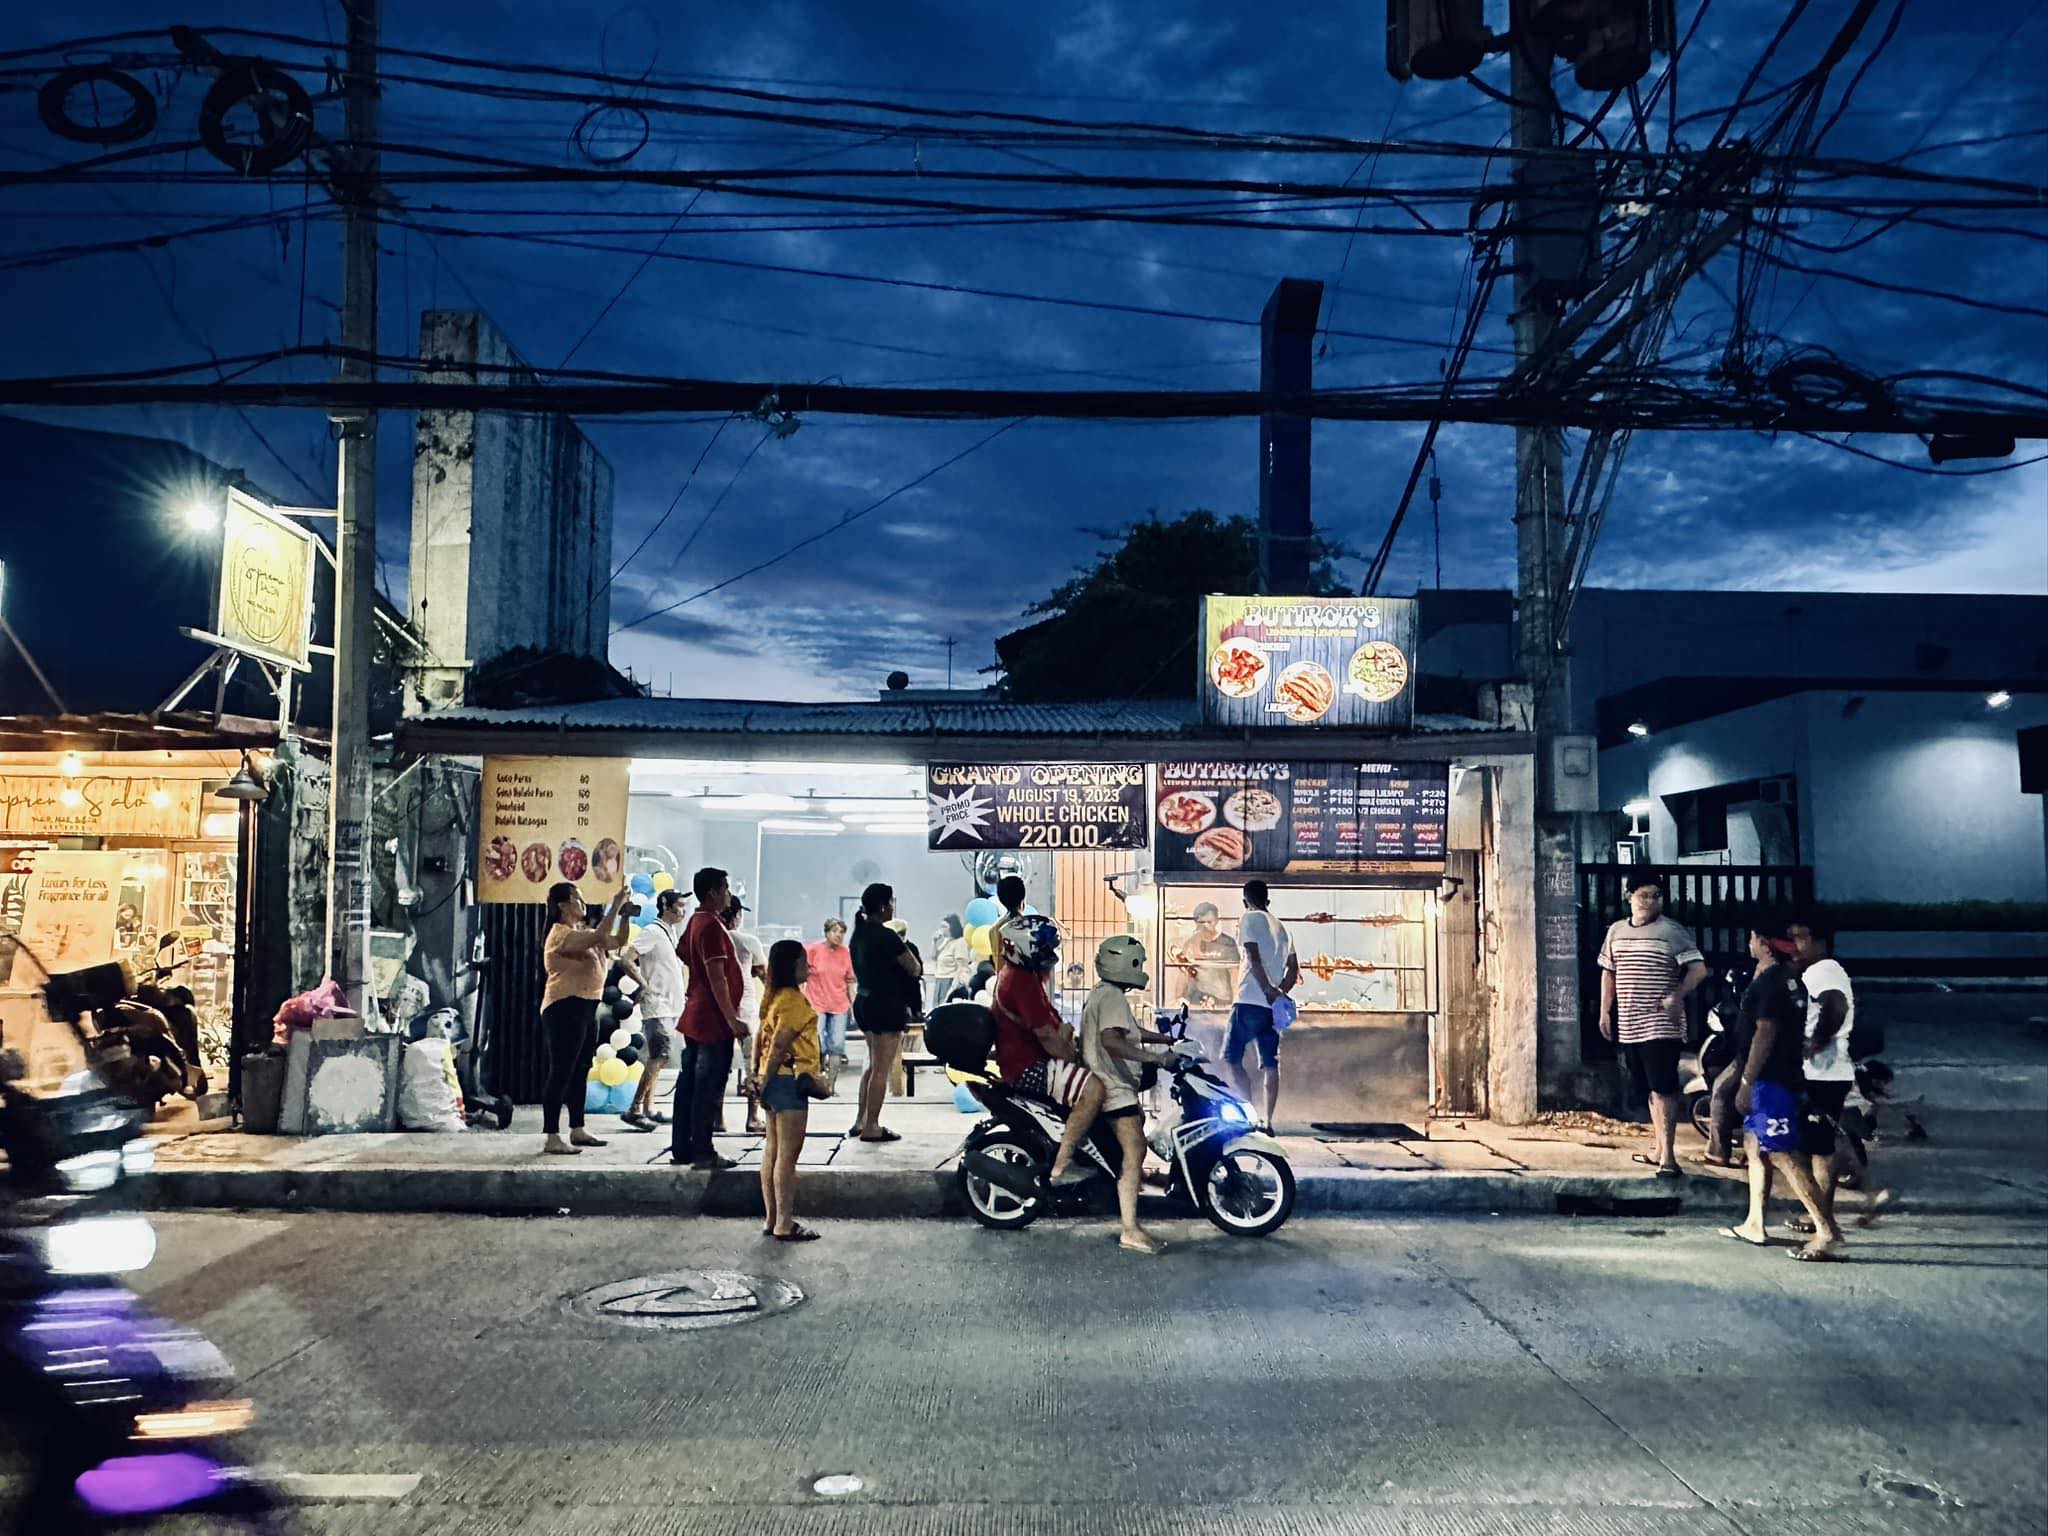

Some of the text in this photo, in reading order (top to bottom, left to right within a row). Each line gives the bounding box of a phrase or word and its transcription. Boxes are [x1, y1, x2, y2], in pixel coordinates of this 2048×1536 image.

[931, 765, 1143, 785] GRAND OPENING
[1360, 763, 1392, 773] MENU
[1007, 789, 1120, 805] AUGUST 19, 2023
[940, 799, 970, 816] PROMO
[996, 806, 1129, 823] WHOLE CHICKEN
[946, 809, 970, 824] PRICE
[1019, 825, 1099, 848] 220.00
[72, 876, 86, 888] for
[38, 890, 109, 904] Fragrance for all
[1766, 1118, 1789, 1137] 23
